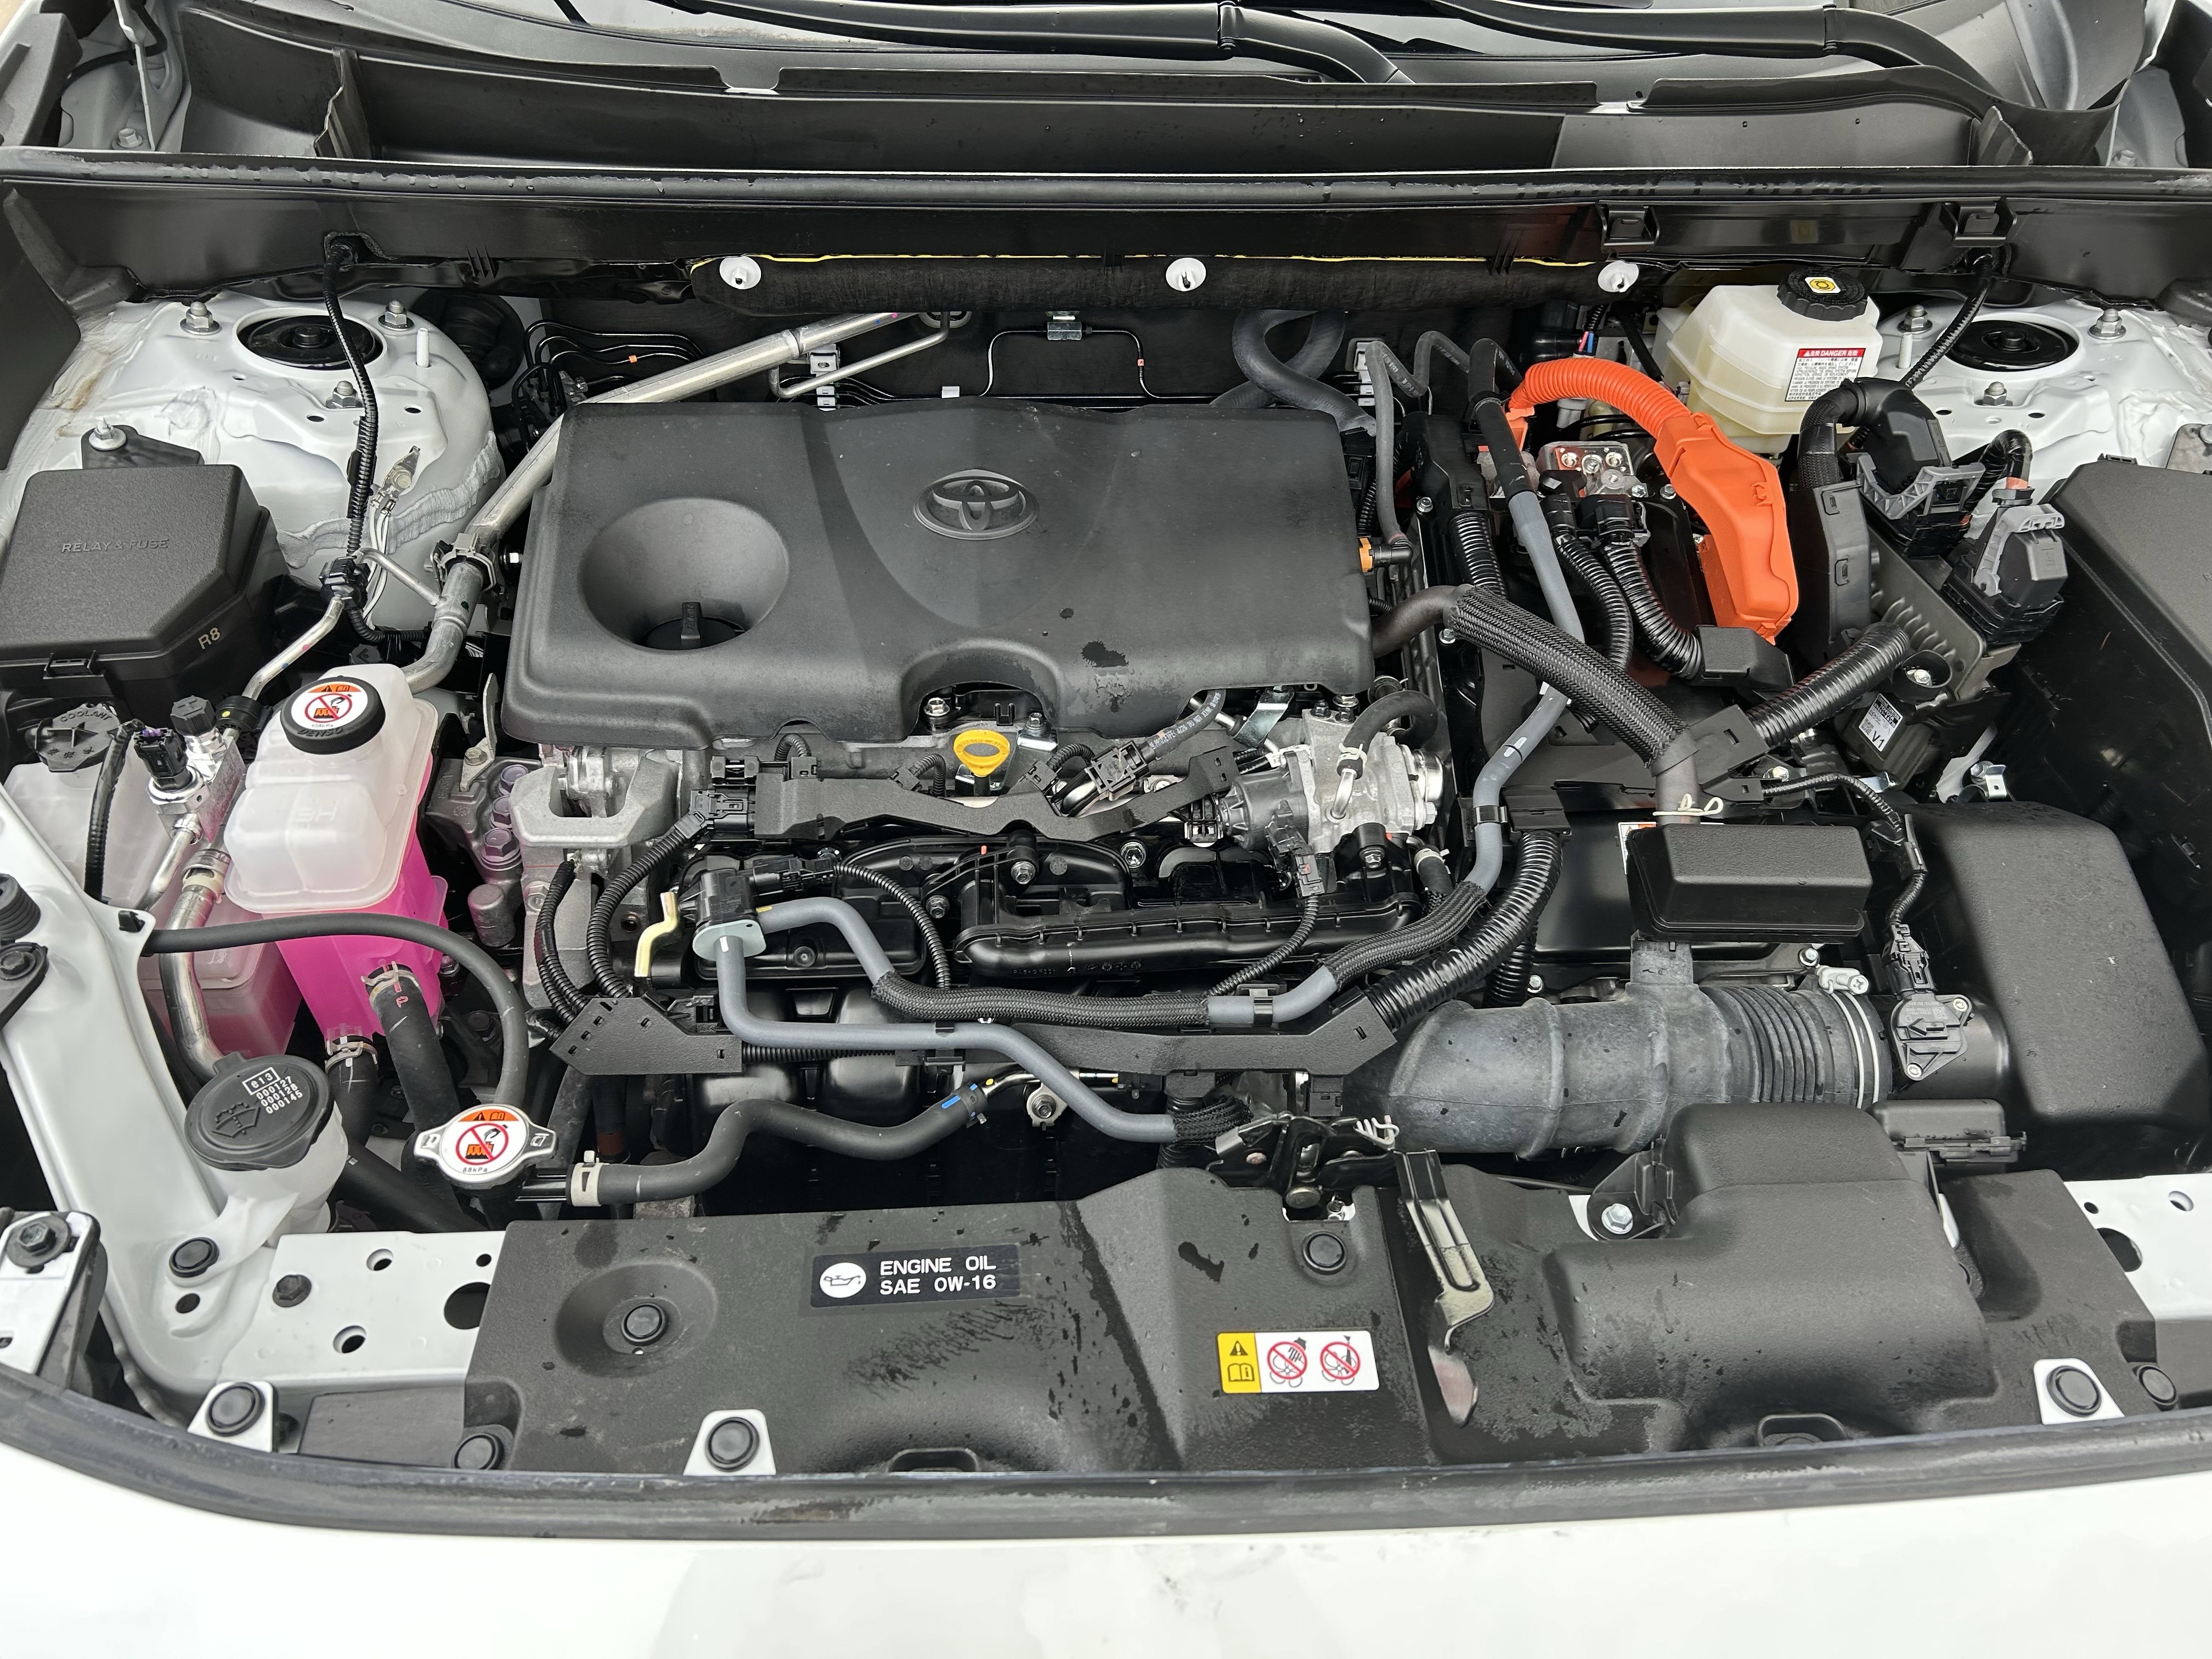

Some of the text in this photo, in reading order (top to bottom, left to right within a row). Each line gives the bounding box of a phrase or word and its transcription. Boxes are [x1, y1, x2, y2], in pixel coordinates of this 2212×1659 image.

[61, 538, 170, 553] RELAY & FUSE
[198, 627, 221, 650] R8
[60, 710, 112, 722] COOLANT
[1880, 703, 1894, 721] TOYOTA
[297, 726, 343, 737] DENSO
[1871, 730, 1885, 749] V1
[251, 1073, 273, 1088] e13
[256, 1076, 292, 1099] 000127
[261, 1083, 298, 1107] 000128
[266, 1090, 303, 1114] 000145
[879, 1255, 997, 1276] ENGINE OIL
[879, 1274, 997, 1295] SAE 0W-16
